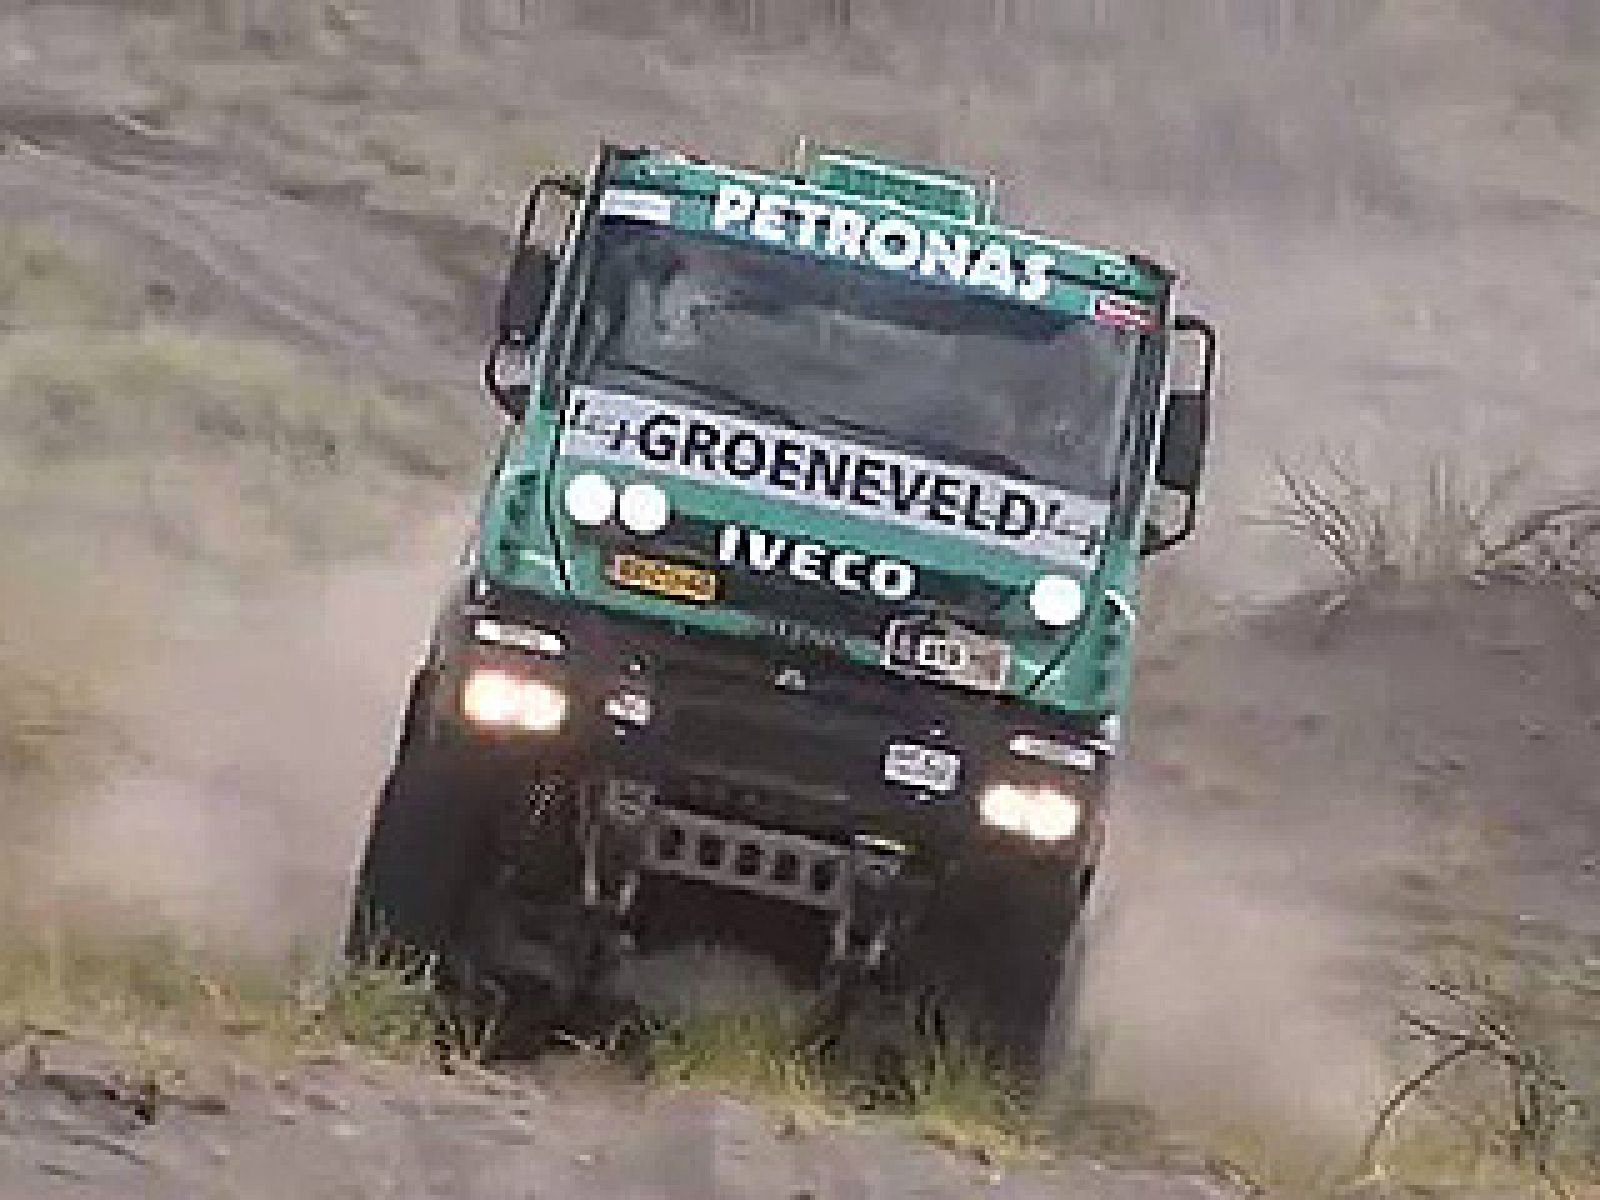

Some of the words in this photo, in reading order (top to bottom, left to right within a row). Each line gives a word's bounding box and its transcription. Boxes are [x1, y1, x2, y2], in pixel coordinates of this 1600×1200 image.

[711, 183, 1056, 301] PETRONAS
[637, 412, 1037, 537] GROENEVELD
[718, 526, 915, 598] IVECO
